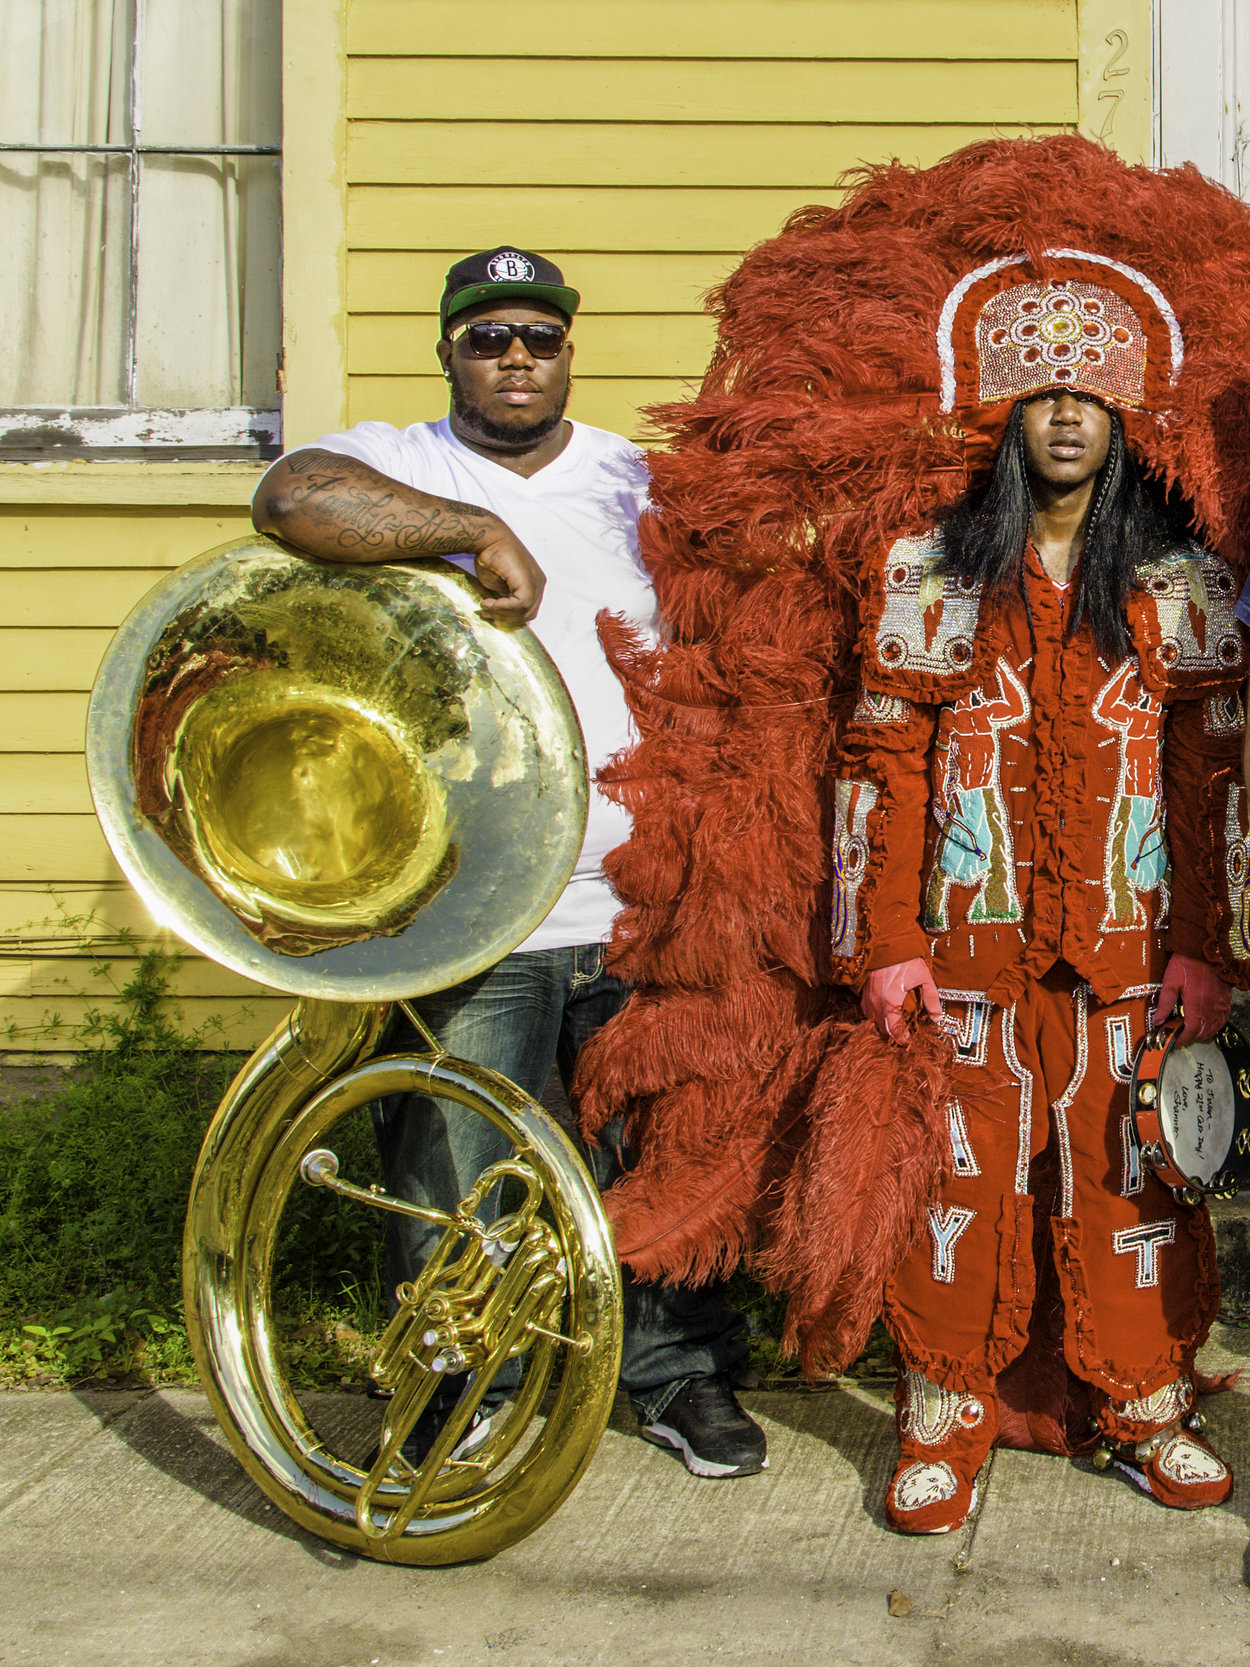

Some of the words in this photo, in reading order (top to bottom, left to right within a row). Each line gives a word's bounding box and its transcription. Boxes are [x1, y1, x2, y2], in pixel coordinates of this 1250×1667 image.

[1098, 29, 1130, 150] 27
[506, 260, 518, 277] B
[291, 474, 396, 548] Family
[1194, 1062, 1204, 1090] Happy
